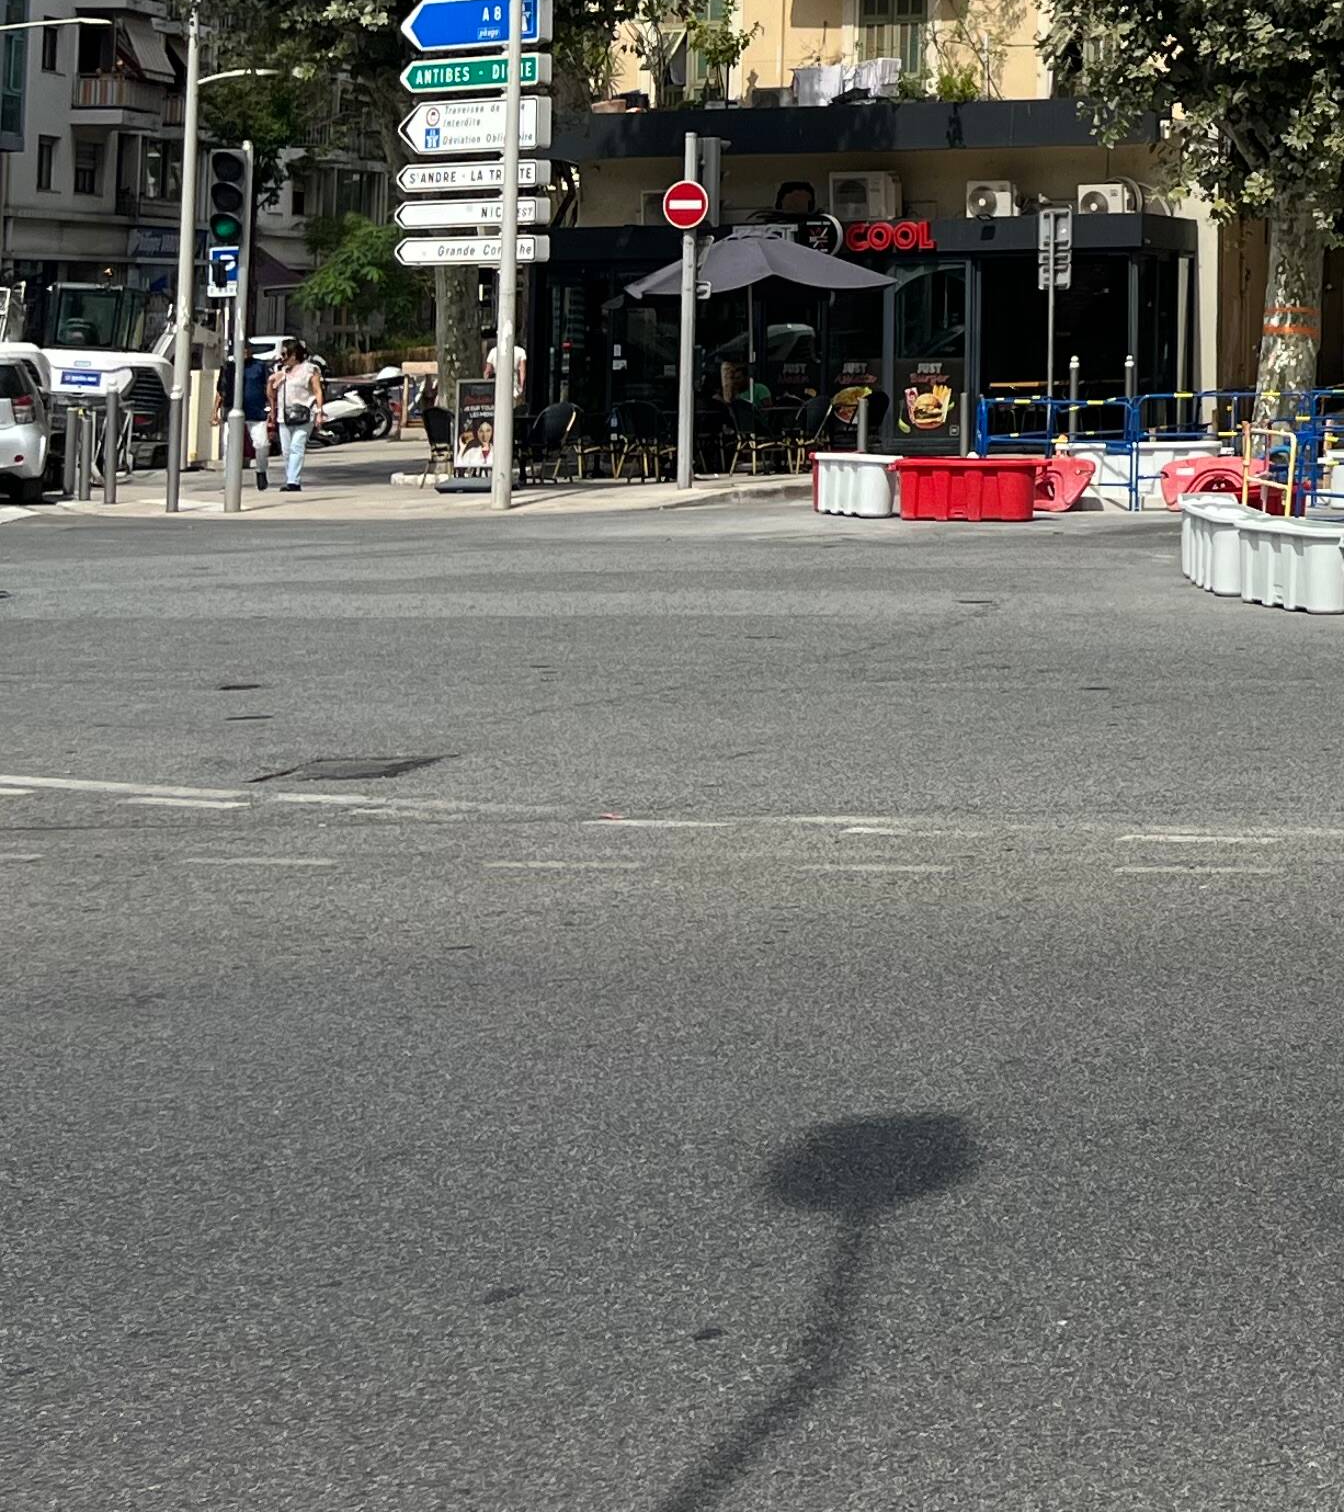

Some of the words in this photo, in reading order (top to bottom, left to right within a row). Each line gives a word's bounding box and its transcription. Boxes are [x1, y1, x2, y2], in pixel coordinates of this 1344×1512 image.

[482, 7, 490, 21] A
[493, 6, 502, 20] 8
[415, 66, 470, 85] ANTIBES
[492, 61, 532, 79] DIE
[470, 170, 483, 181] LA
[489, 168, 532, 180] TRTE
[846, 221, 936, 252] COOL
[437, 246, 476, 257] Grande
[482, 243, 531, 256] Corhe
[917, 363, 943, 374] JUST
